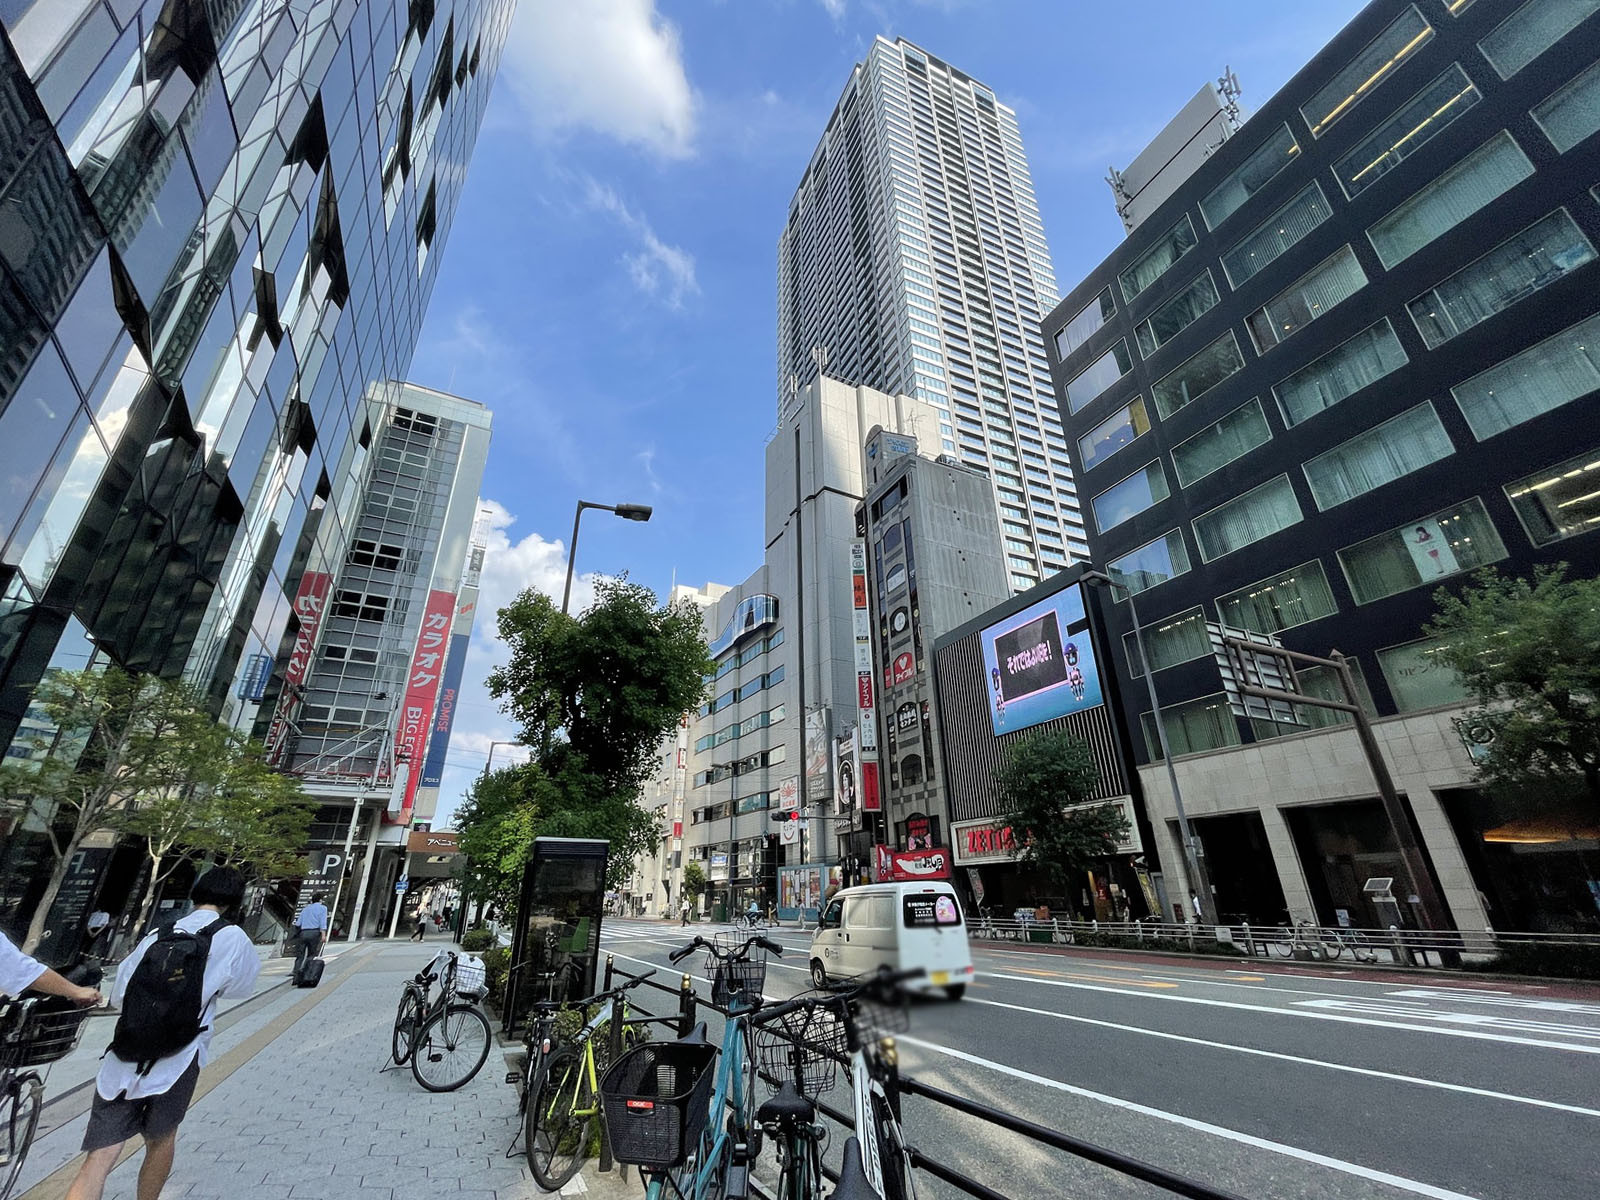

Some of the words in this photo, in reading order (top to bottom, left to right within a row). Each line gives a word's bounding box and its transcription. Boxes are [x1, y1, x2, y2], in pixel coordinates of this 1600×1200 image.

[412, 613, 448, 687] カラオケ
[863, 683, 871, 707] アイフル
[407, 706, 422, 733] BIG
[436, 688, 455, 732] PROMISE
[401, 735, 415, 765] ECH
[321, 854, 342, 875] P
